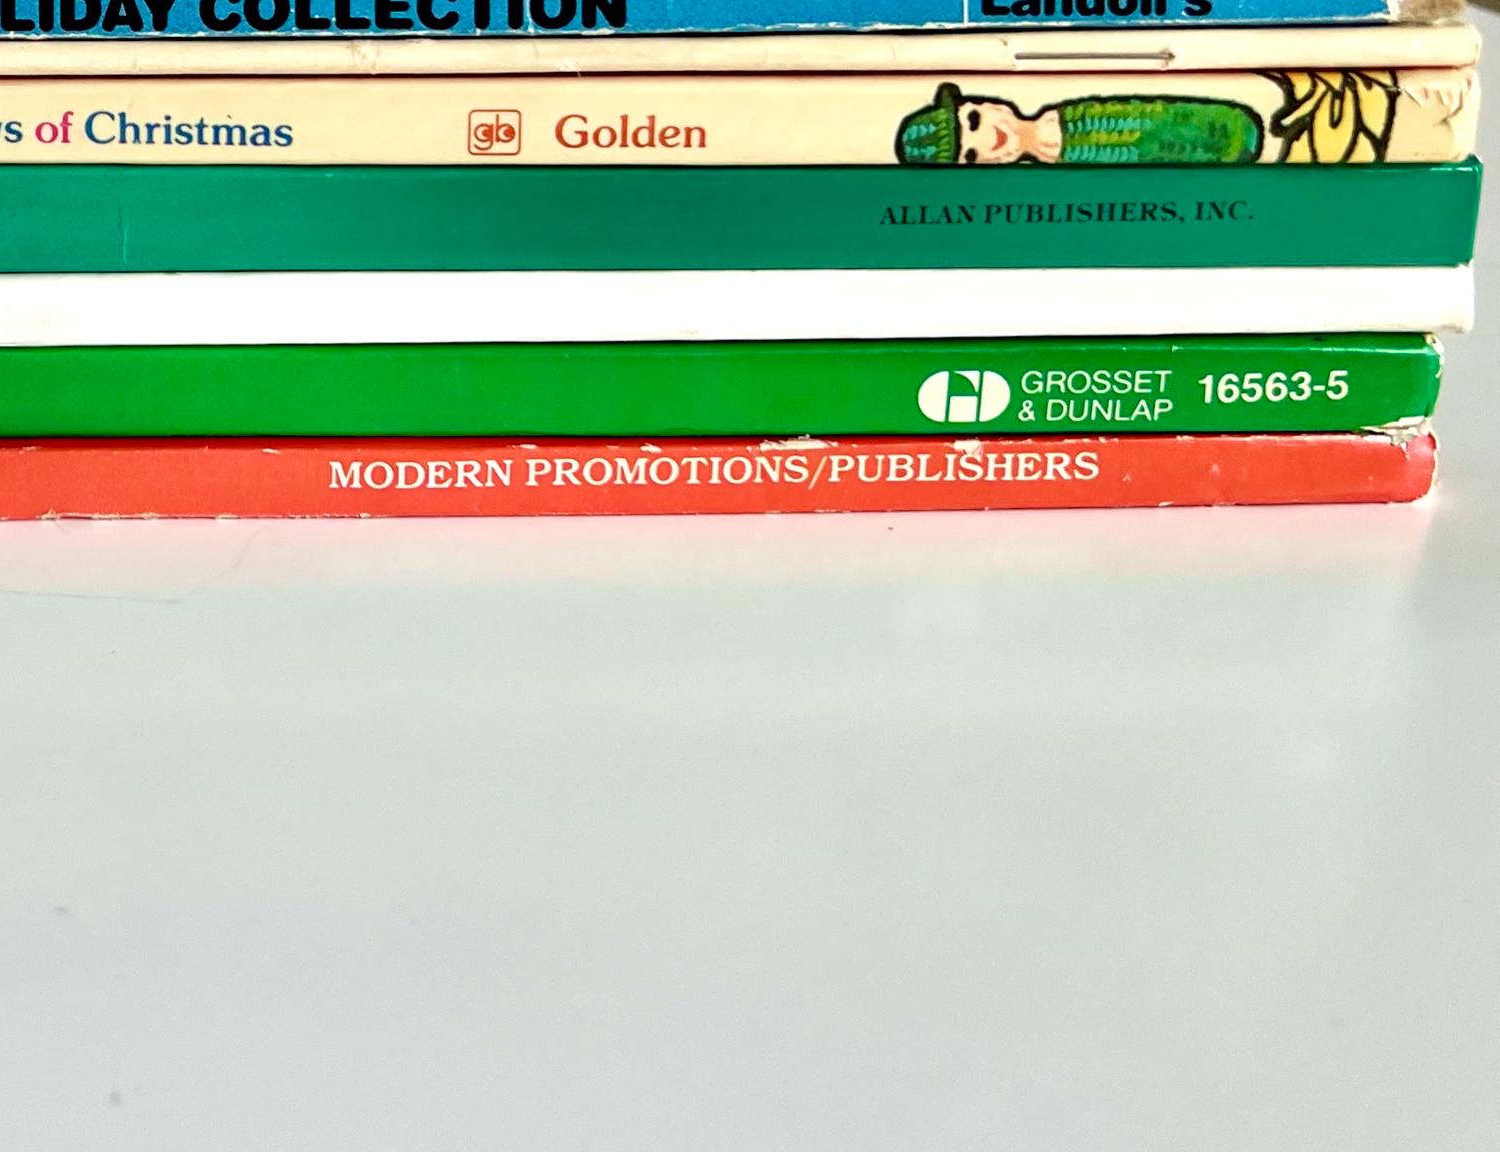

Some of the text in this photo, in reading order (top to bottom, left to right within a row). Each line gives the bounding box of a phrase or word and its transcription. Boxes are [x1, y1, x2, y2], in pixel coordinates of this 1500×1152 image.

[34, 109, 74, 145] of
[83, 110, 294, 148] Christmas
[554, 114, 708, 150] Golden
[880, 200, 1255, 226] ALLAN PUBLISHERS, INC.
[1021, 370, 1172, 395] GROSSET
[1198, 370, 1349, 405] 16563-5
[1018, 399, 1173, 422] & DUNLAP
[328, 451, 1100, 490] MODERN PROMOTIONS/PUBLISHERS
